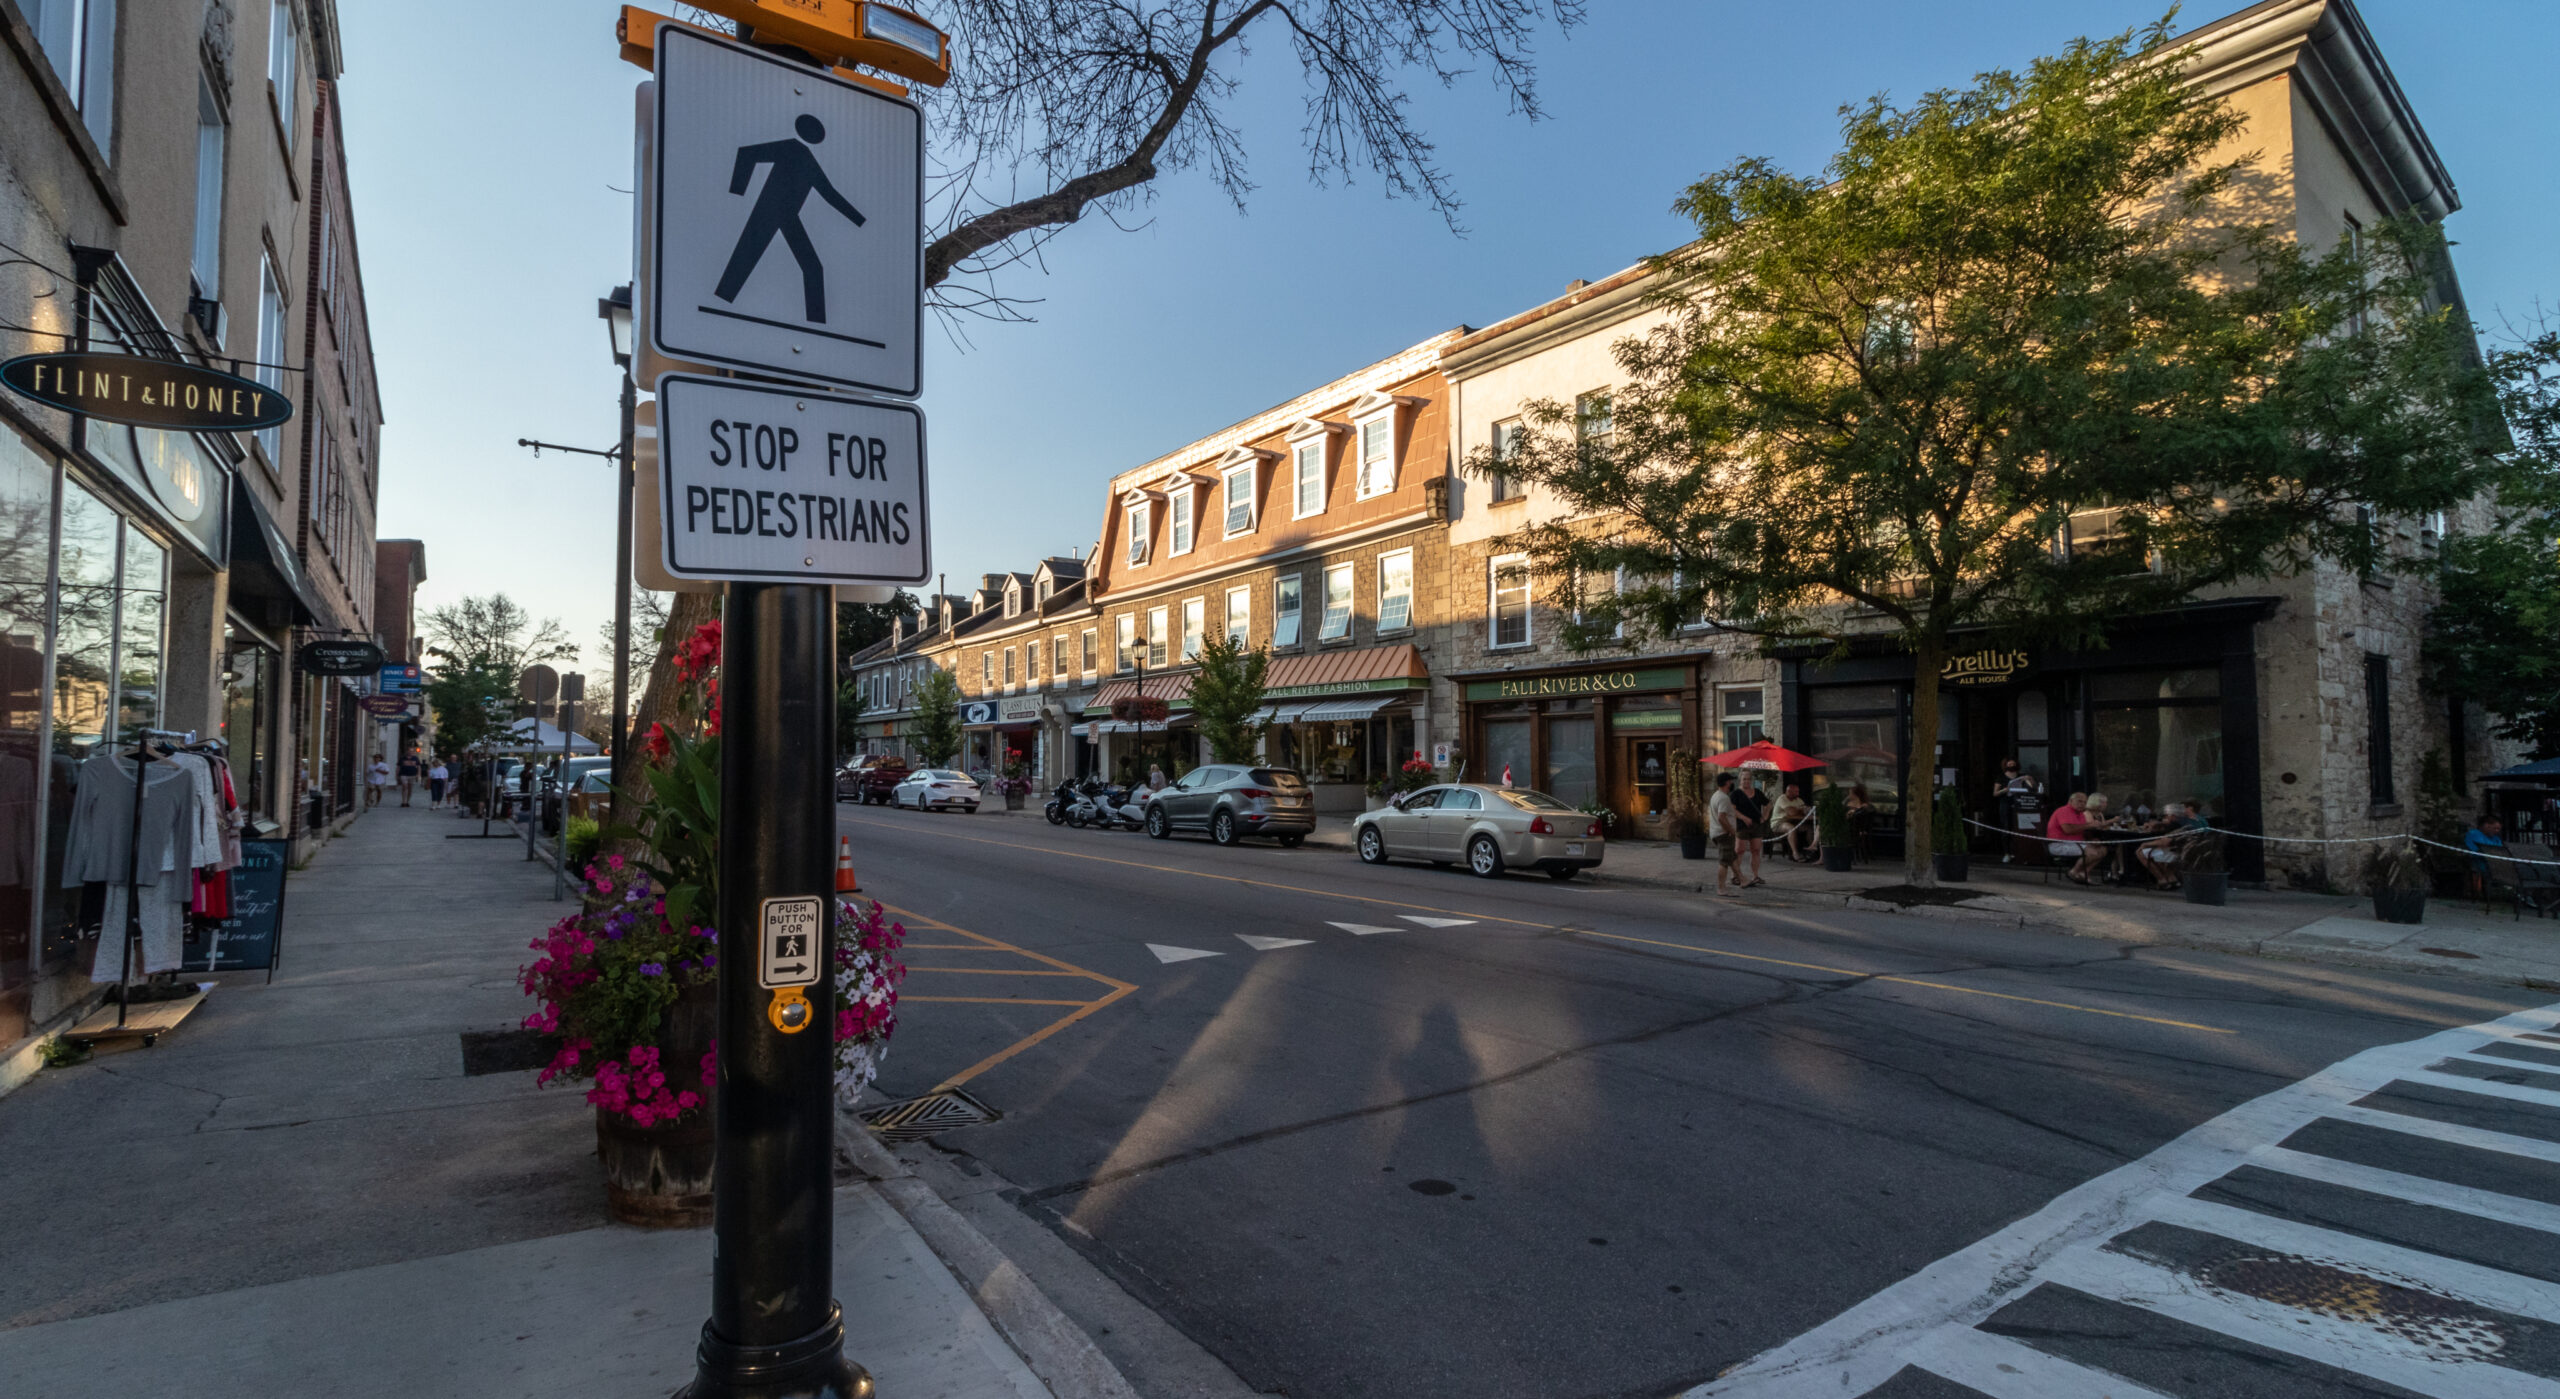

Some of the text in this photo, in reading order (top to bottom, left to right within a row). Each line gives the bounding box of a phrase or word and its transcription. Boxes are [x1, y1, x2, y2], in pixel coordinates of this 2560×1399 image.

[710, 419, 888, 482] STOP FOR
[686, 485, 910, 545] PEDESTRIANS
[315, 648, 368, 656] Crossroads
[1960, 675, 2008, 685] ALE HOUSE
[1267, 682, 1370, 697] FALL RIVER FASHION
[778, 904, 807, 914] PUSH
[770, 913, 815, 925] BUTTON
[781, 924, 803, 934] FOR
